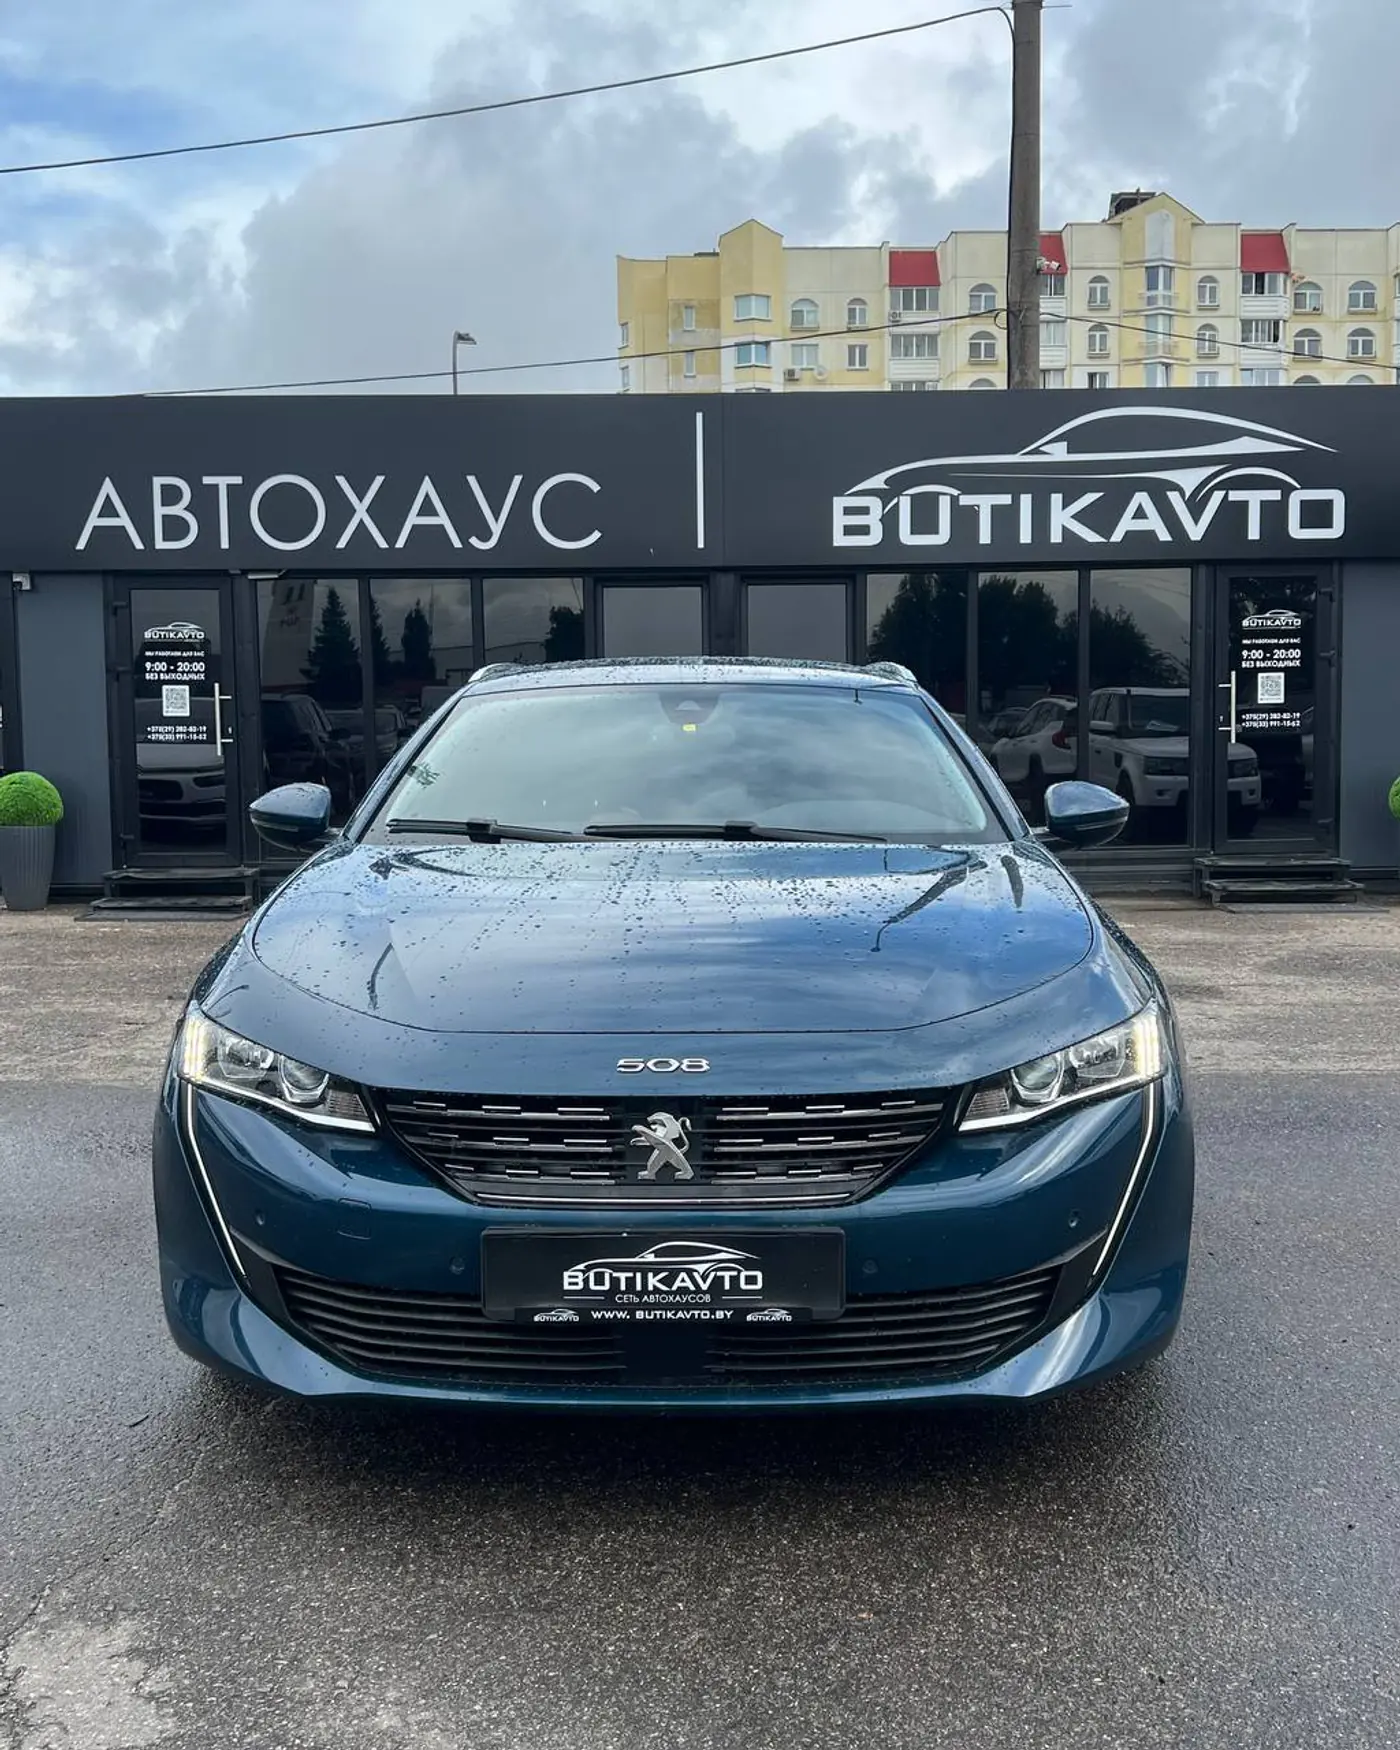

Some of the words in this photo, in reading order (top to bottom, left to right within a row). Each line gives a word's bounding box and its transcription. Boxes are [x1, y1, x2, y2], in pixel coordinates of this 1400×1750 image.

[76, 473, 602, 551] АВТОХАУС
[832, 488, 1346, 547] BUTIKAVTO
[1242, 619, 1302, 627] BUTIKAVTO
[144, 631, 205, 639] BUTIKAVTO
[1241, 649, 1264, 659] 9:00
[1272, 649, 1302, 659] 20:00
[144, 661, 168, 671] 9:00
[176, 661, 205, 672] 20:00
[1241, 660, 1255, 668] БЕЗ
[1255, 660, 1301, 668] ВЫХОДНЫХ
[159, 673, 205, 681] ВЫХОДНЫХ
[616, 1058, 711, 1073] 508
[563, 1270, 763, 1291] BUTIKAVTO
[615, 1294, 640, 1304] СЕТЬ
[641, 1293, 712, 1304] АВТОХАУСОВ
[533, 1313, 580, 1322] BUTIKAVTO
[635, 1310, 734, 1320] BUTIKAVTO.BY
[746, 1313, 793, 1322] BUTIKAVTO
